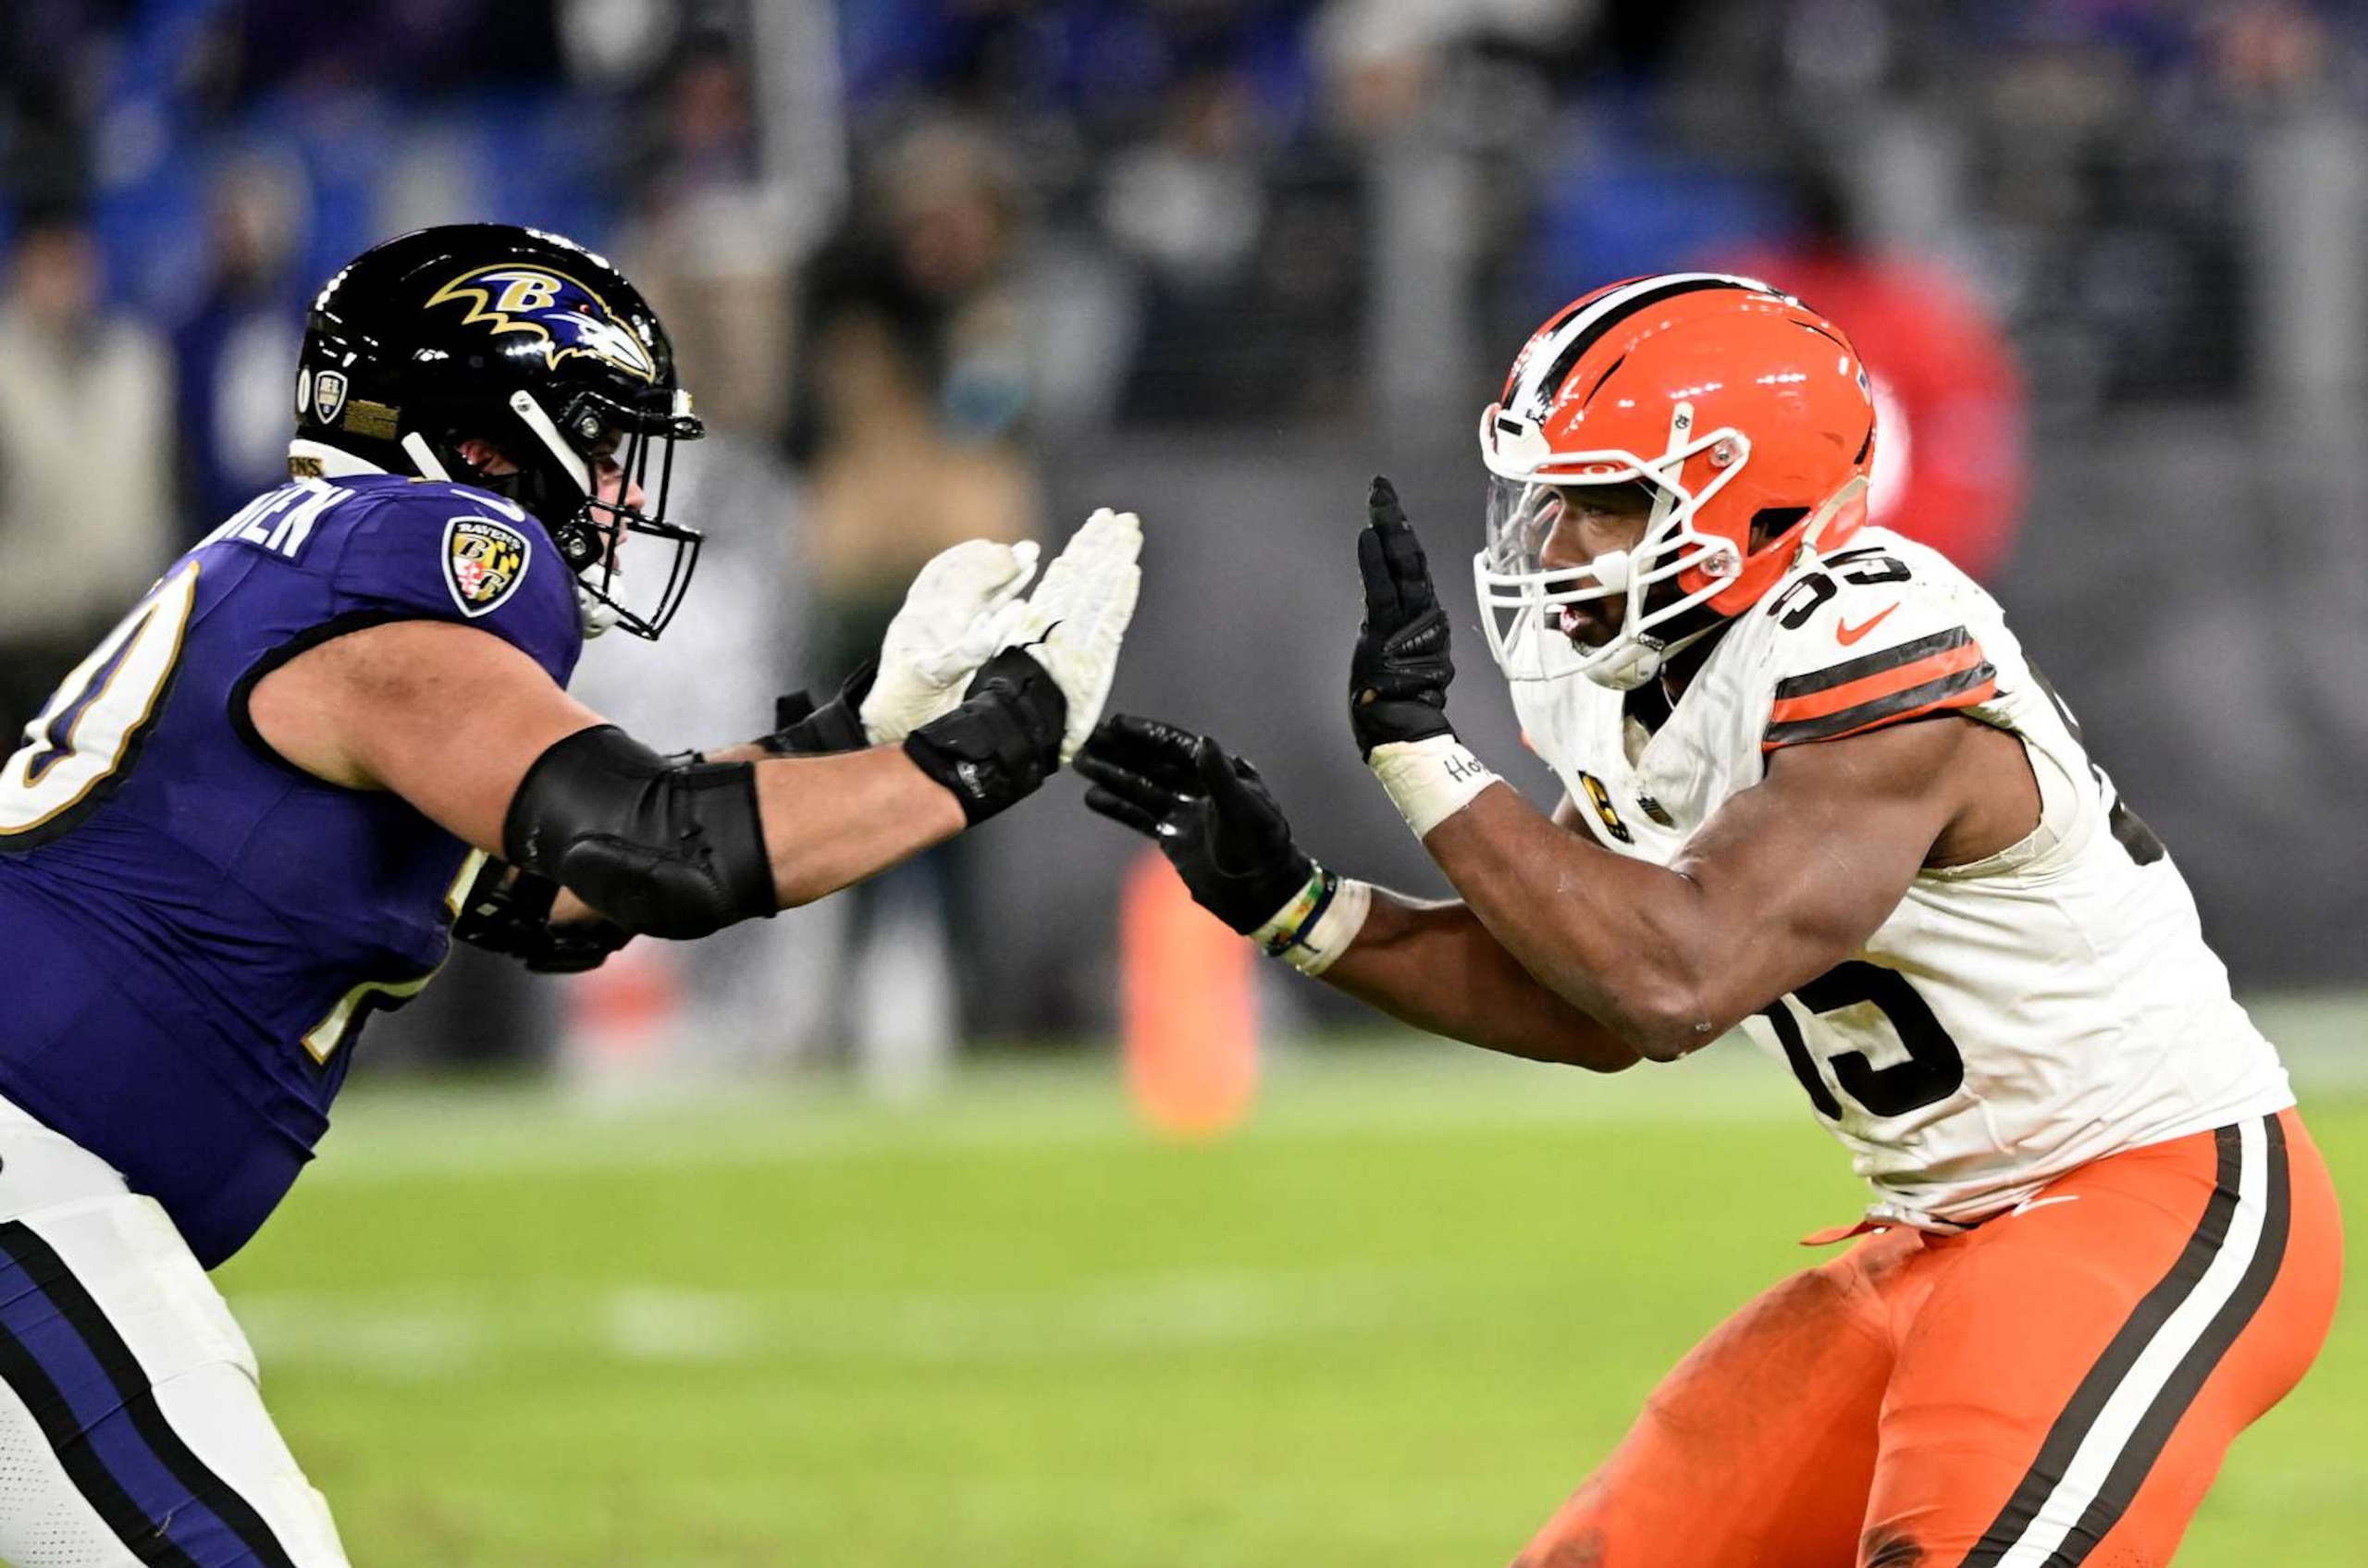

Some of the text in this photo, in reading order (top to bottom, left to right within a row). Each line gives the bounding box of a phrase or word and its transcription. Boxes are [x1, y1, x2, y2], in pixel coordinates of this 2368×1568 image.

[490, 271, 562, 312] B
[457, 523, 522, 550] RAVENS
[1766, 547, 1912, 630] 95
[1765, 959, 1965, 1120] 5
